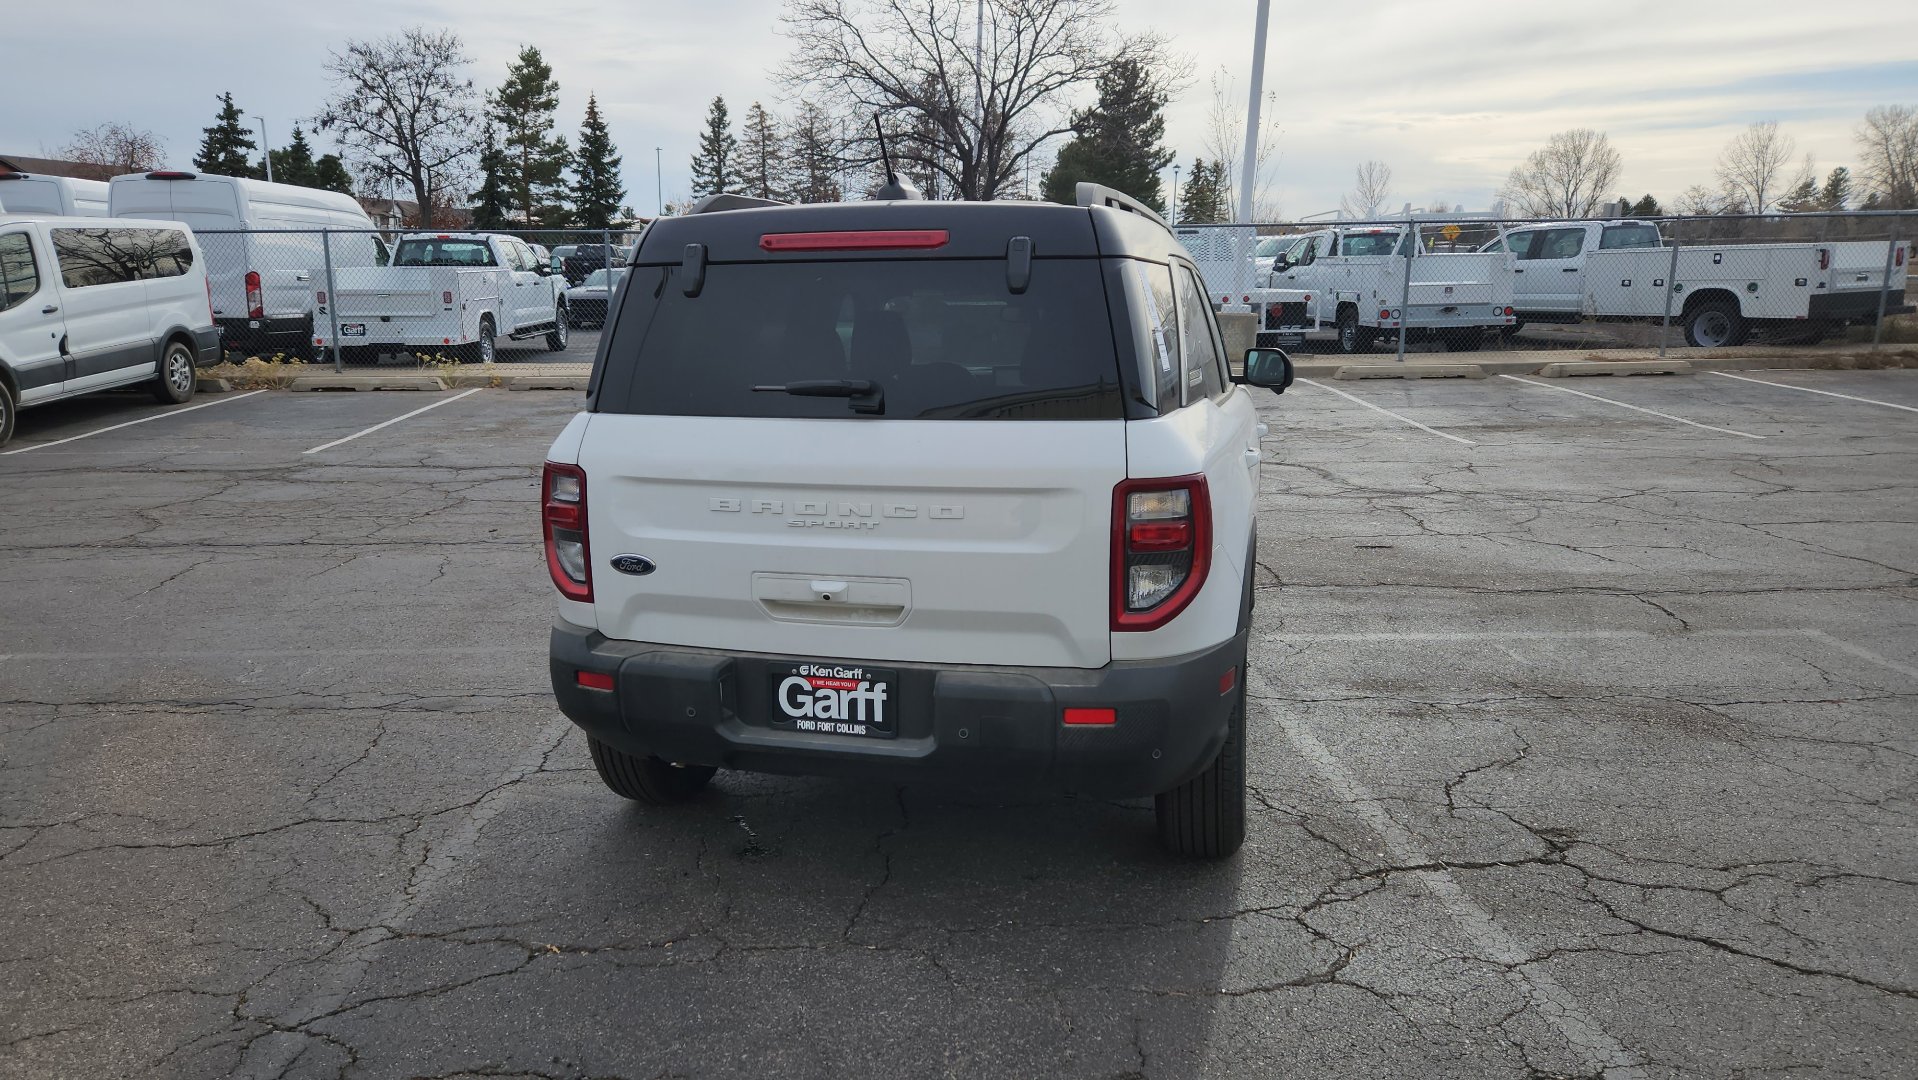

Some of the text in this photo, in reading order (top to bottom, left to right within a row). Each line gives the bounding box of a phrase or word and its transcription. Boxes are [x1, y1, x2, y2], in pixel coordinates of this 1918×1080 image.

[709, 497, 965, 520] BRONCO
[787, 519, 880, 530] SPORT
[810, 664, 863, 679] Ken Garff
[778, 675, 888, 722] Garff
[796, 719, 866, 735] FORD FORT COLLINS
